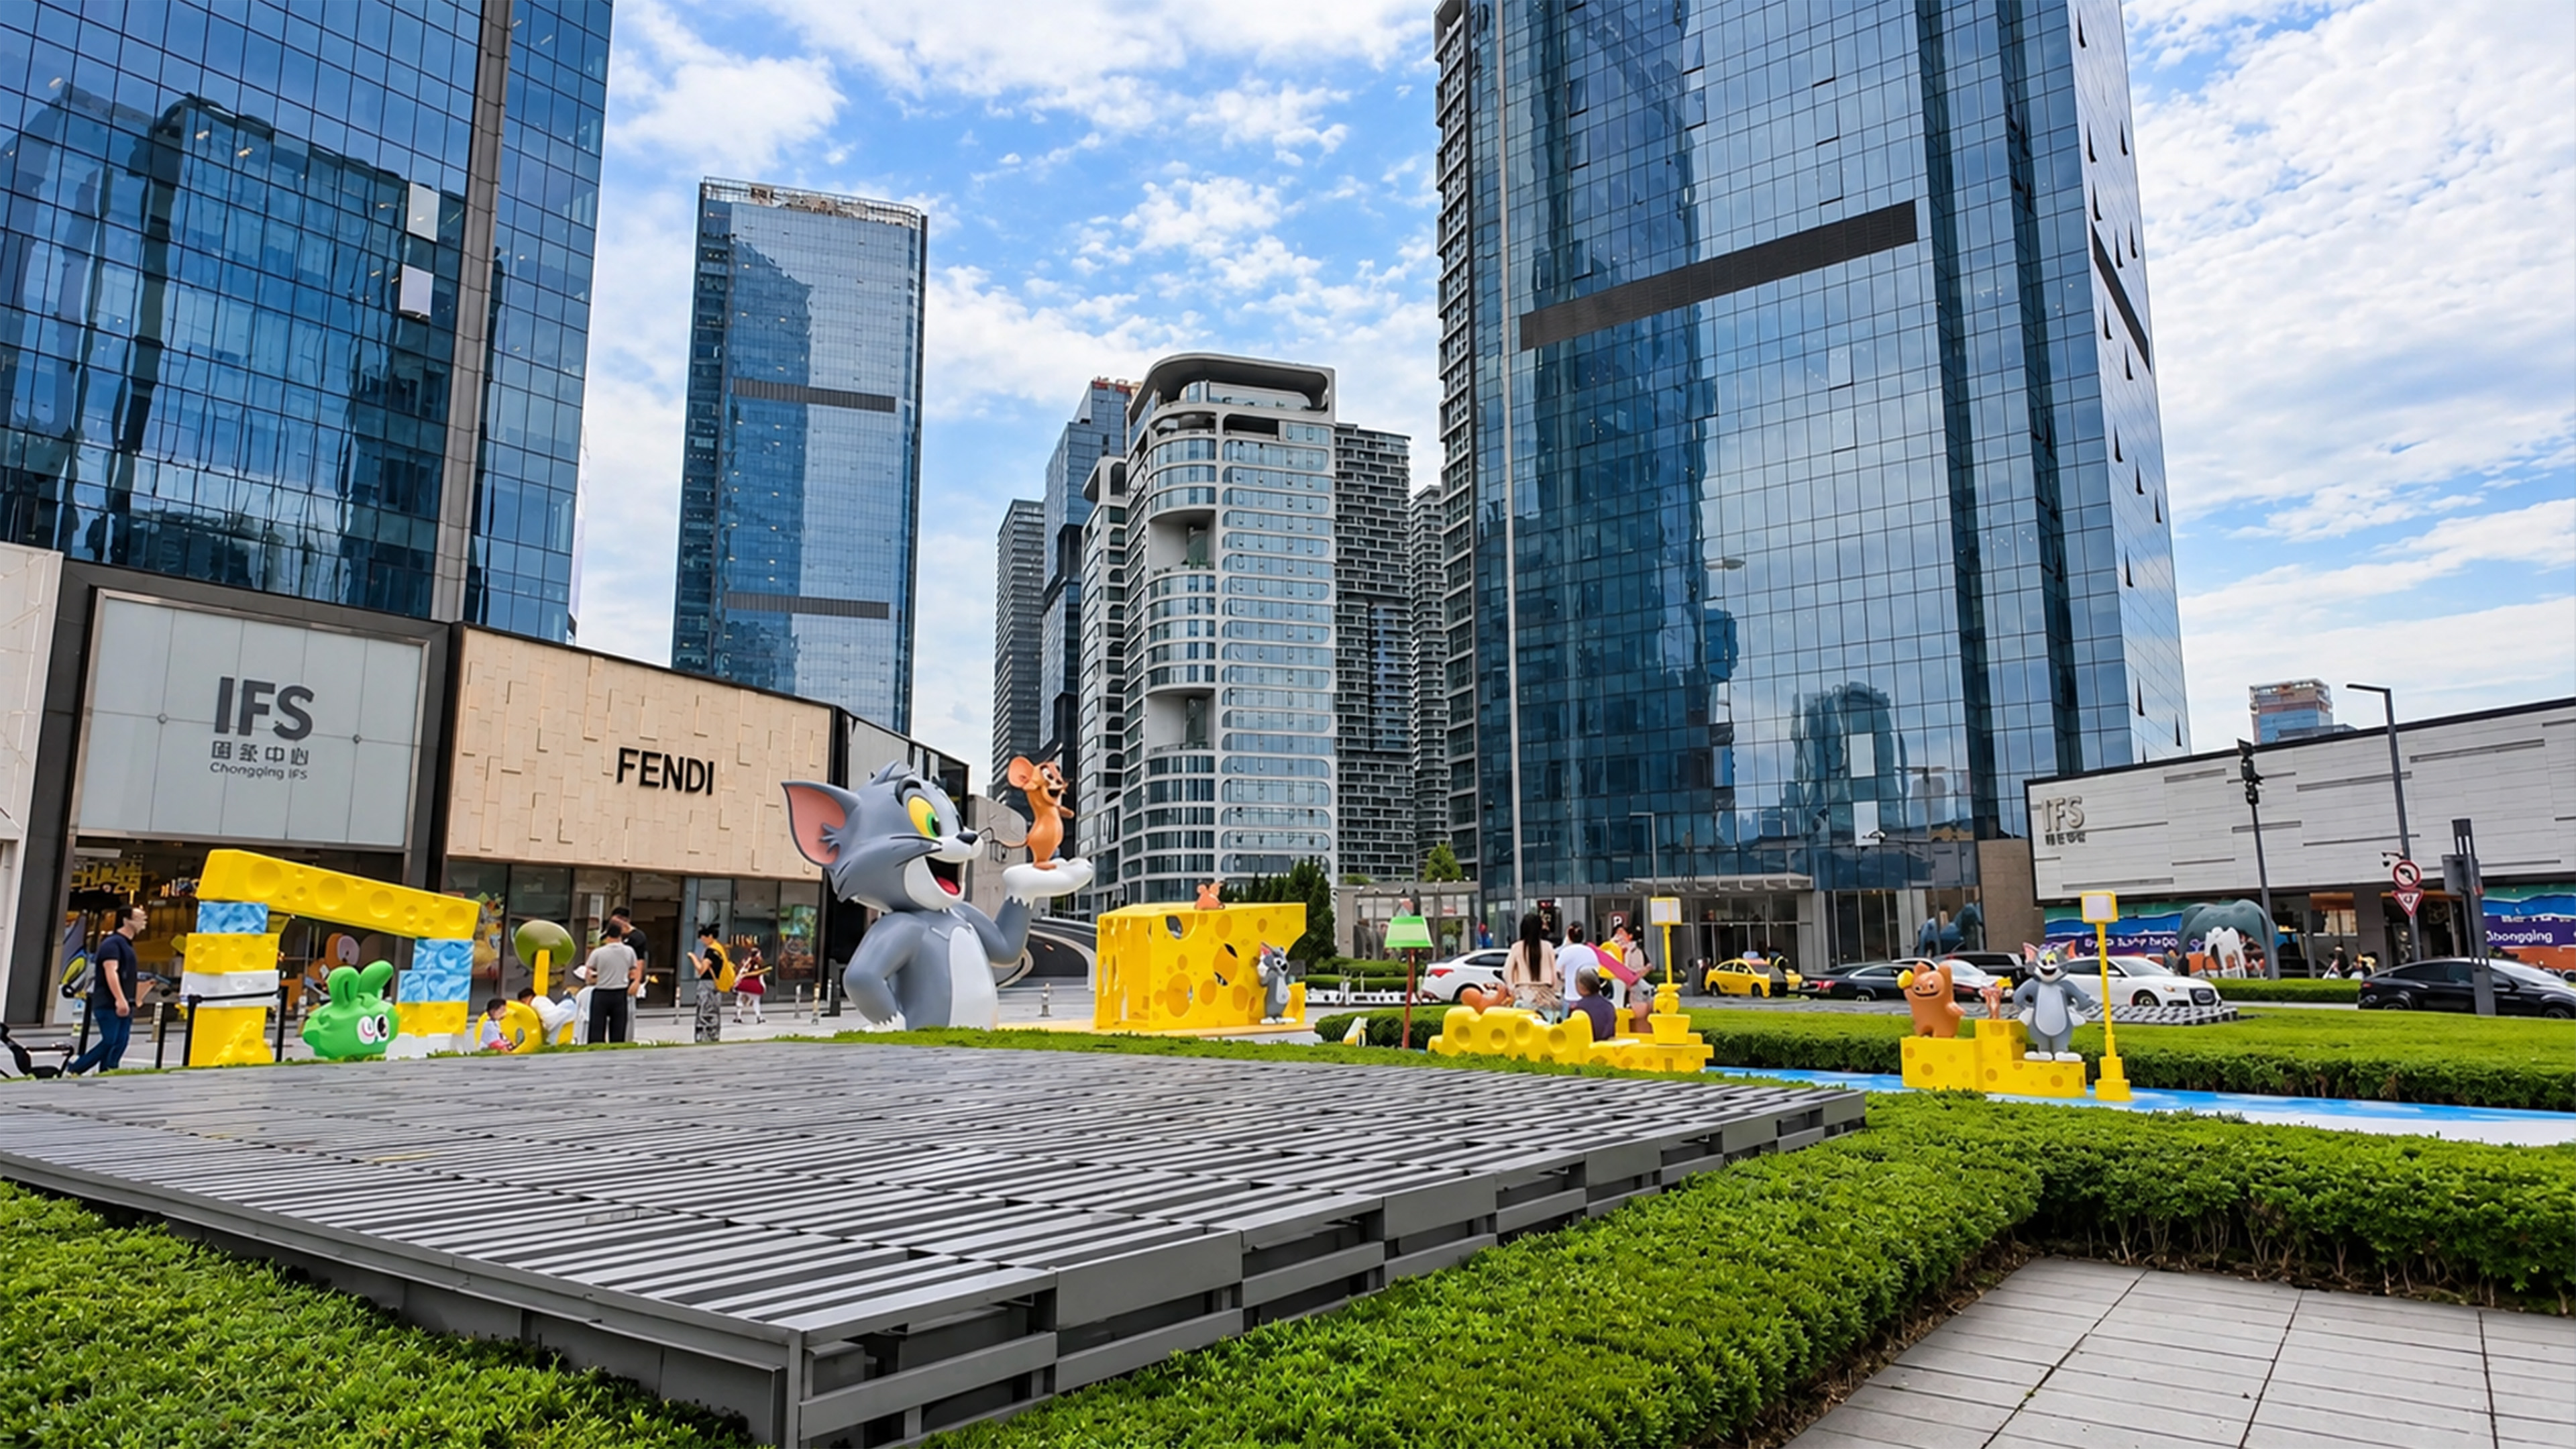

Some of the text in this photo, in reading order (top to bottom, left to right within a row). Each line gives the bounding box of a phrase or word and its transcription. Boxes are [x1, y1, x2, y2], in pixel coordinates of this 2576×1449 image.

[215, 676, 315, 741] IFS
[210, 761, 308, 780] Chongqing IFS
[616, 747, 714, 796] FENDI
[2043, 796, 2084, 832] IFS
